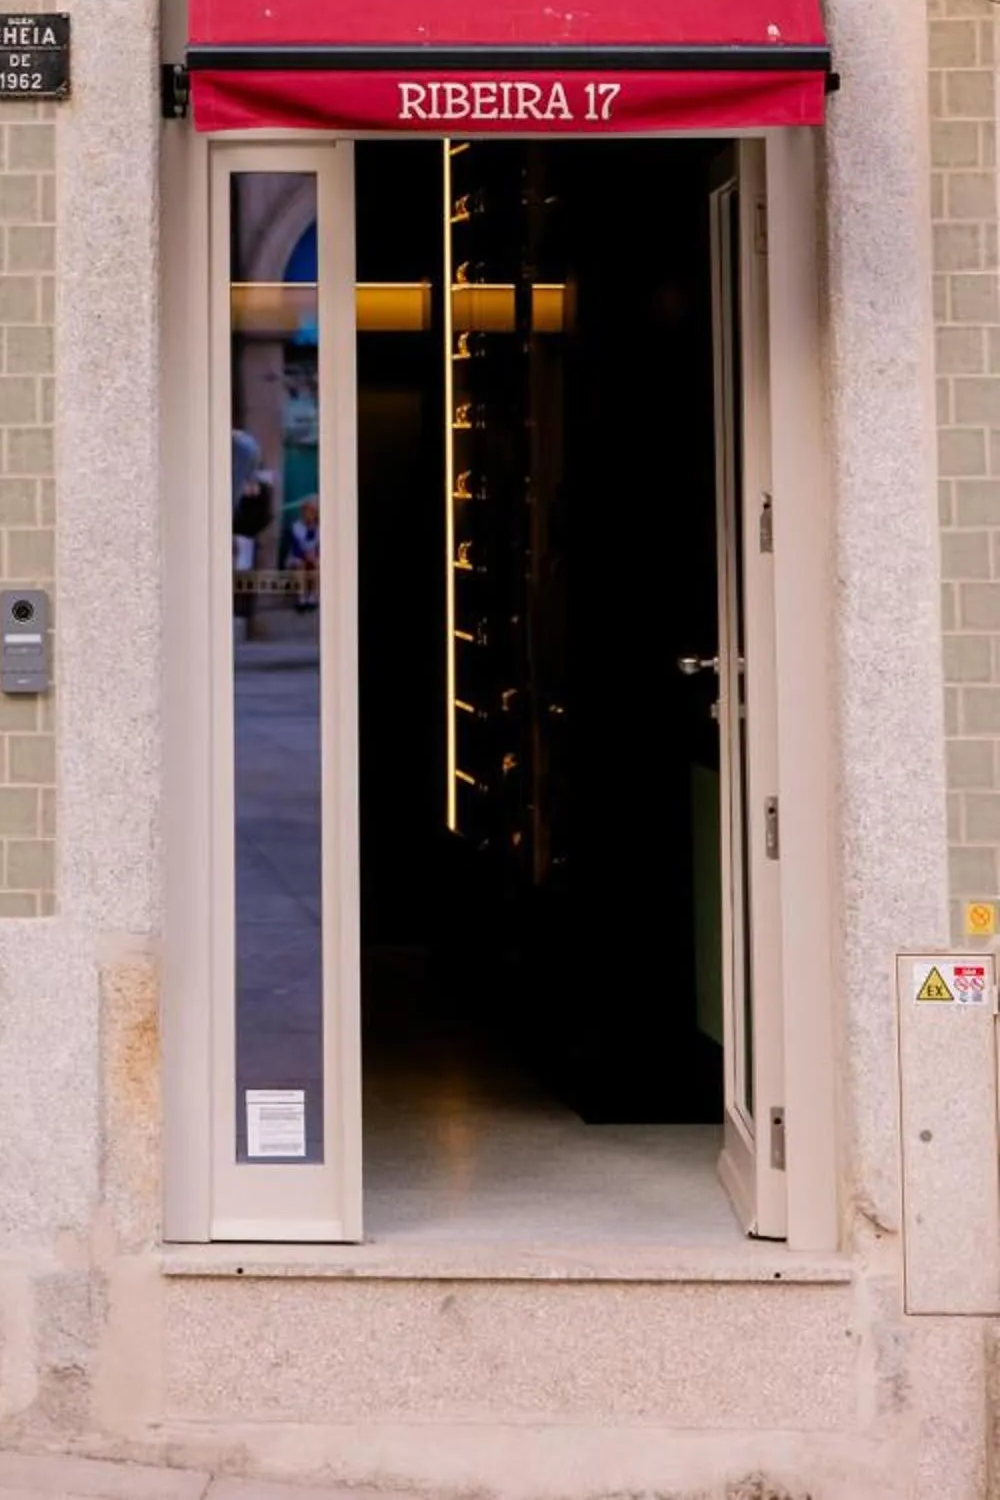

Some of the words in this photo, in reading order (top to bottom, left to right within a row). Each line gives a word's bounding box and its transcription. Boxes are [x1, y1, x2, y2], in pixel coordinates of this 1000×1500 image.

[9, 53, 31, 67] DE
[397, 80, 574, 121] RIBEIRA
[584, 82, 622, 121] 17
[926, 985, 943, 997] EX
